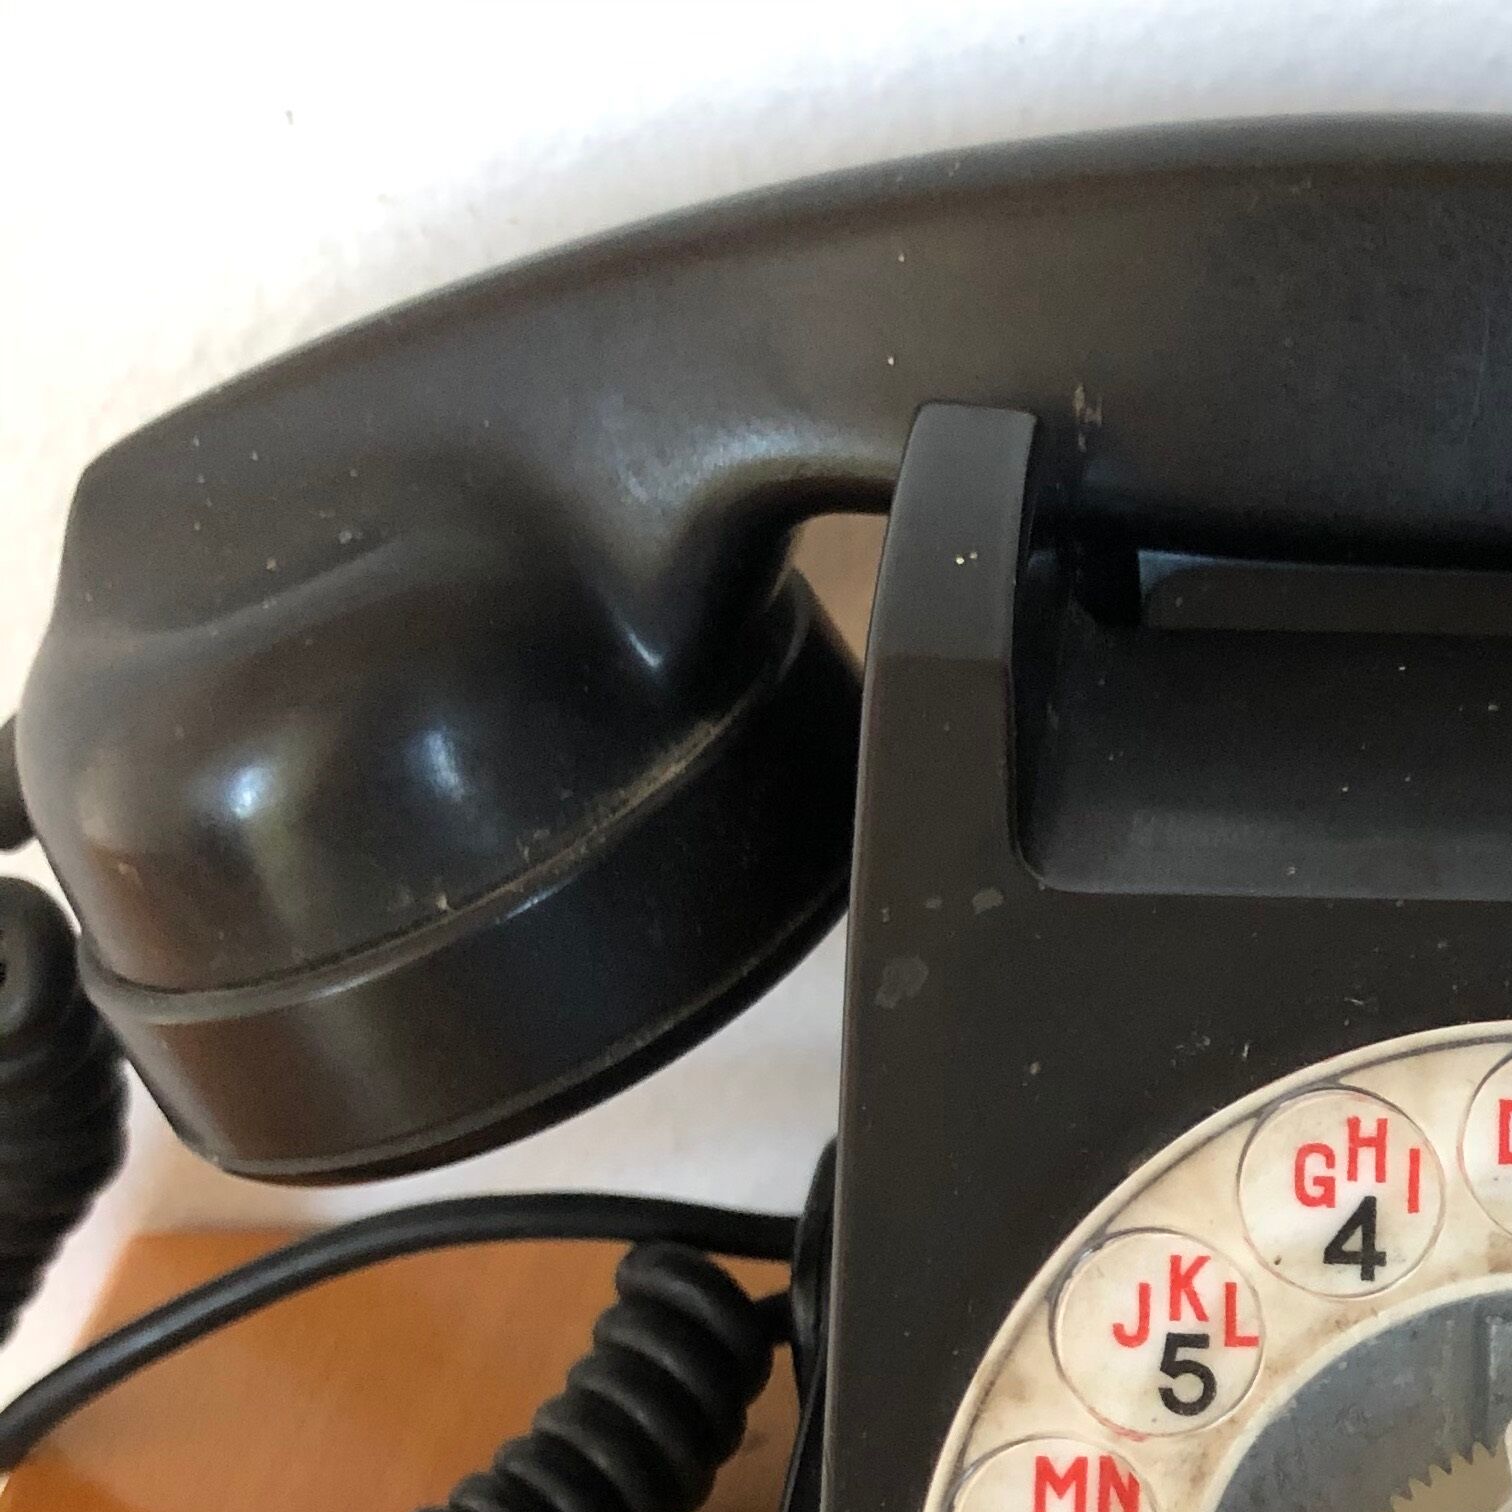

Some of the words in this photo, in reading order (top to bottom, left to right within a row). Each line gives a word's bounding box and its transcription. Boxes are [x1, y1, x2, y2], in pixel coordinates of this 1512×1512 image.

[1294, 1116, 1421, 1214] GHI
[1322, 1196, 1387, 1281] 4
[1112, 1254, 1260, 1349] JKL
[1158, 1332, 1217, 1416] 5
